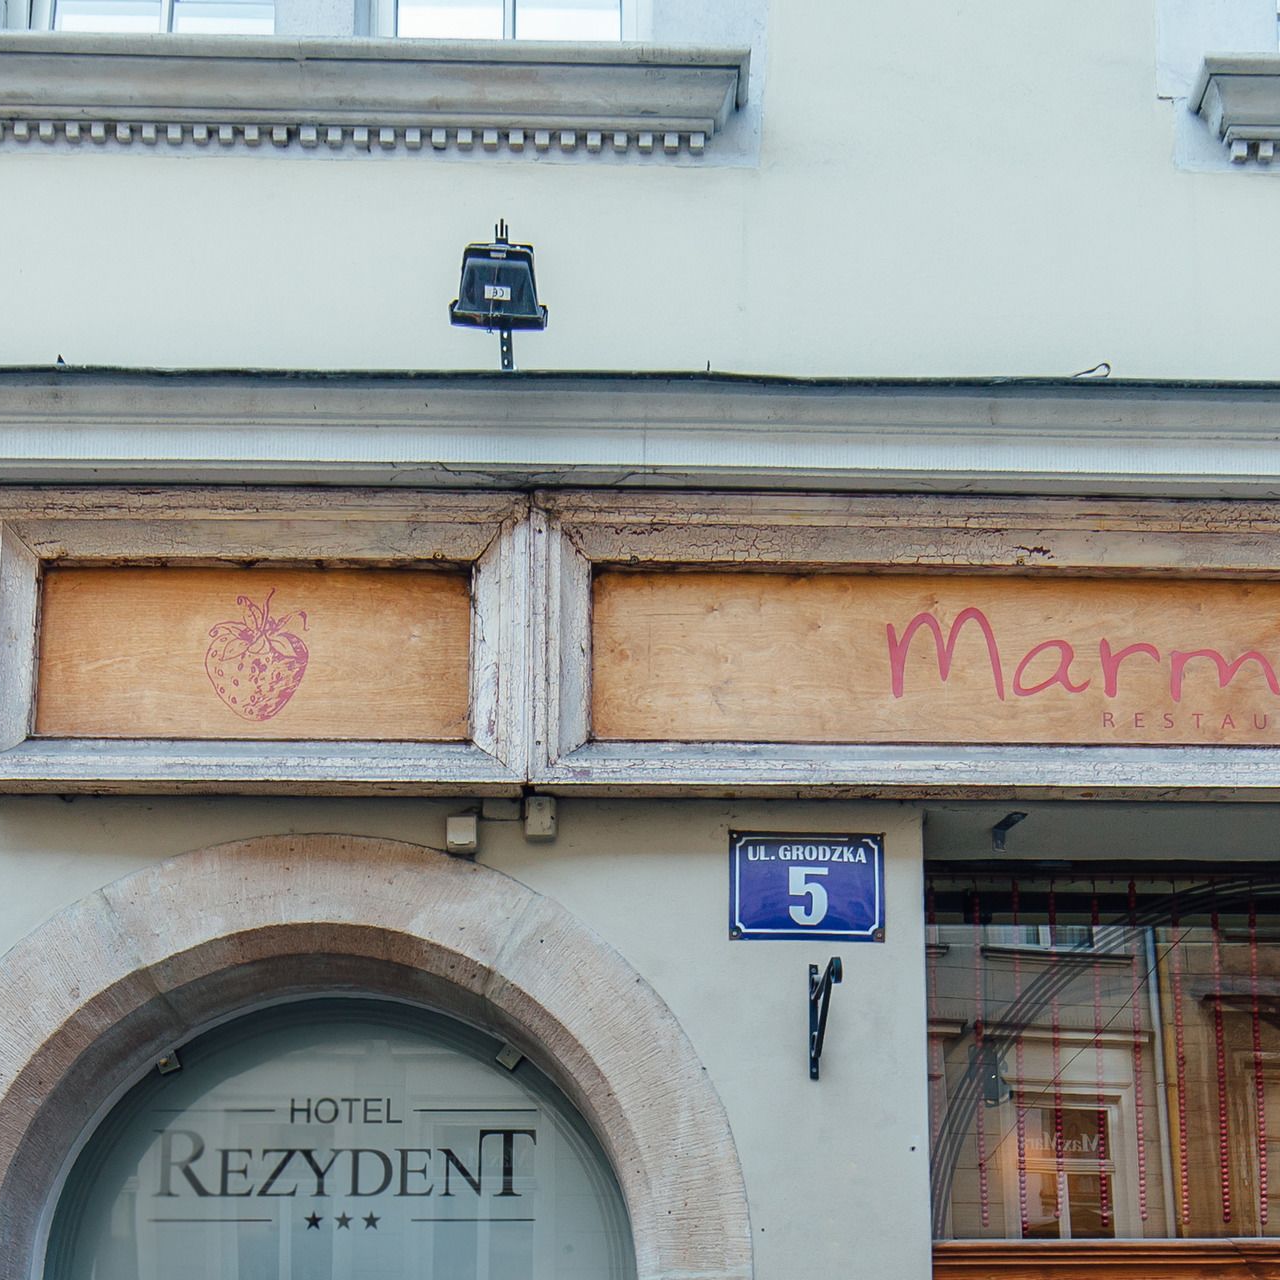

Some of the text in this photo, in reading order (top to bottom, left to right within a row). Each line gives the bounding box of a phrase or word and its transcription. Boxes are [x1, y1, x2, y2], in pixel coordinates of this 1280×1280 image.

[747, 845, 867, 864] UL. GRODZKA
[788, 866, 829, 926] 5
[290, 1097, 403, 1125] HOTEL
[151, 1128, 537, 1198] REZYDENT
